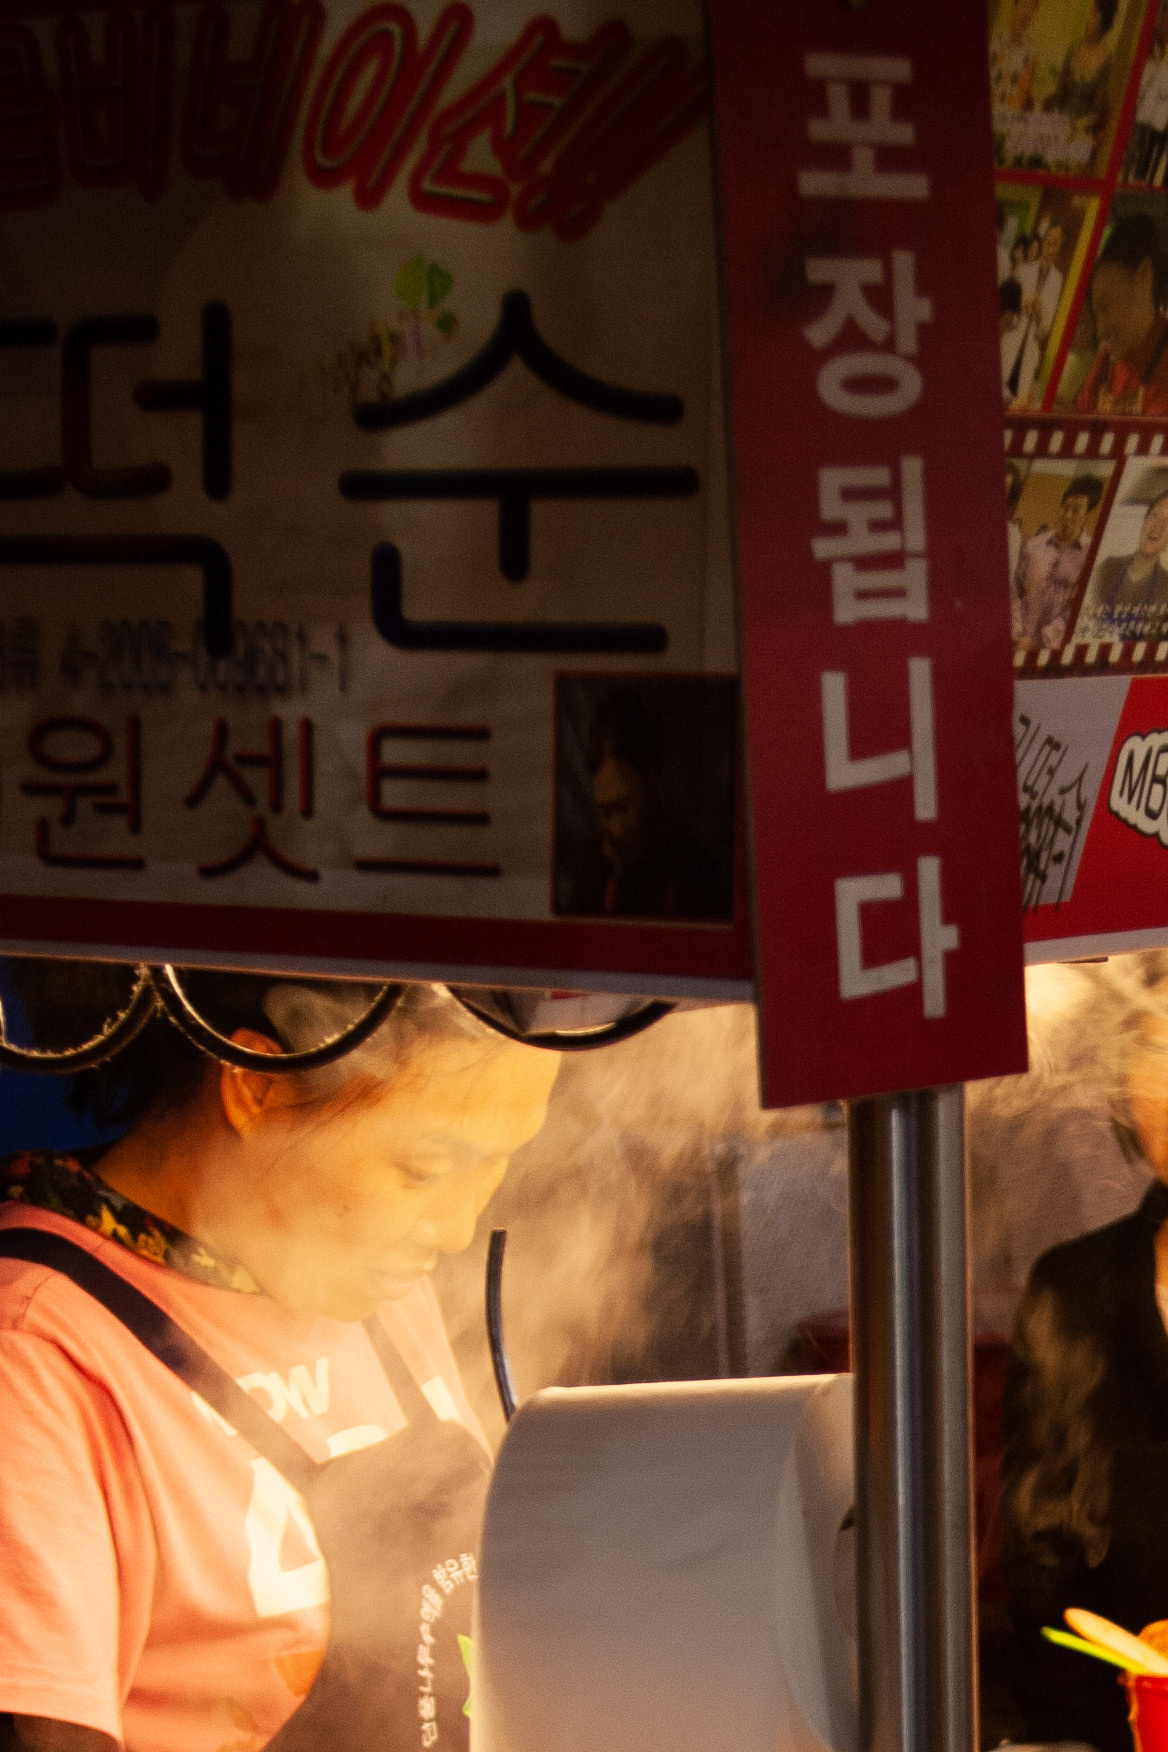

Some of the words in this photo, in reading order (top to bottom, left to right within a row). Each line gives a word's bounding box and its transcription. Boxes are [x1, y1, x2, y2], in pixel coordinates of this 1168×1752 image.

[0, 289, 700, 657] 떡순
[798, 52, 960, 1021] 포장됩니다
[20, 713, 502, 883] 원셋트
